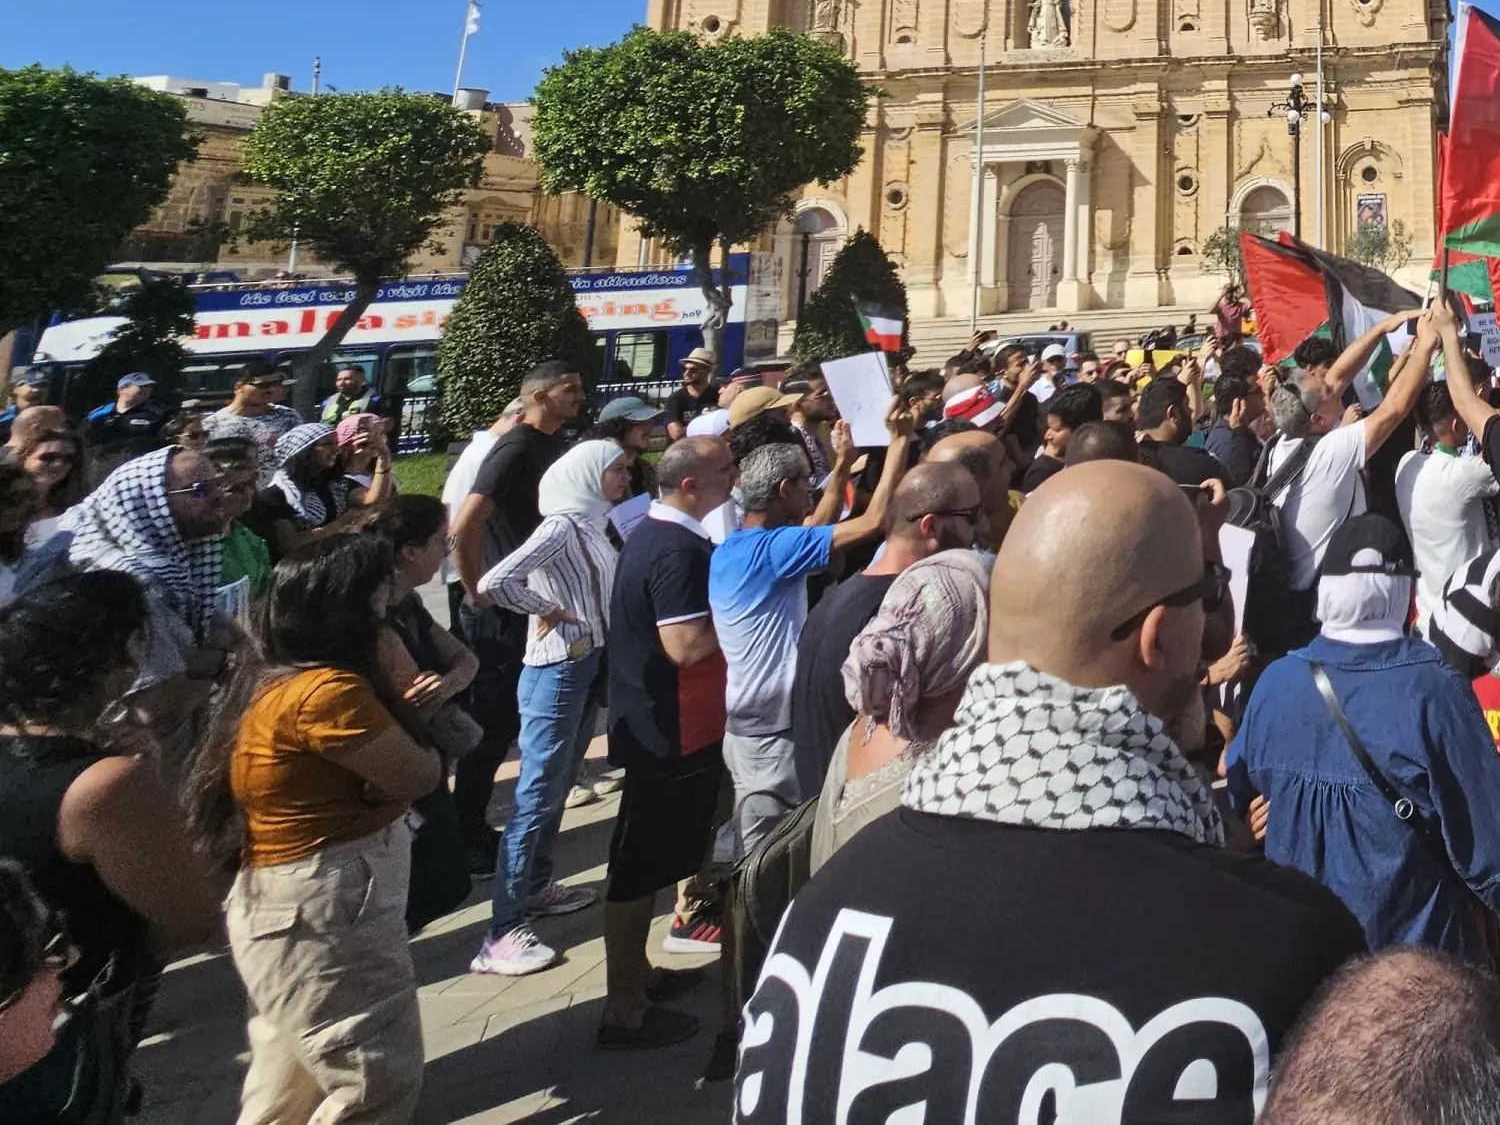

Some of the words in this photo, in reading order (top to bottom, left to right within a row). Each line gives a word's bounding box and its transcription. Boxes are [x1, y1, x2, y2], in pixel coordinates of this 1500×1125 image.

[275, 290, 316, 303] best
[387, 284, 426, 299] visit
[593, 274, 688, 289] attractions
[734, 903, 1270, 1125] alace
